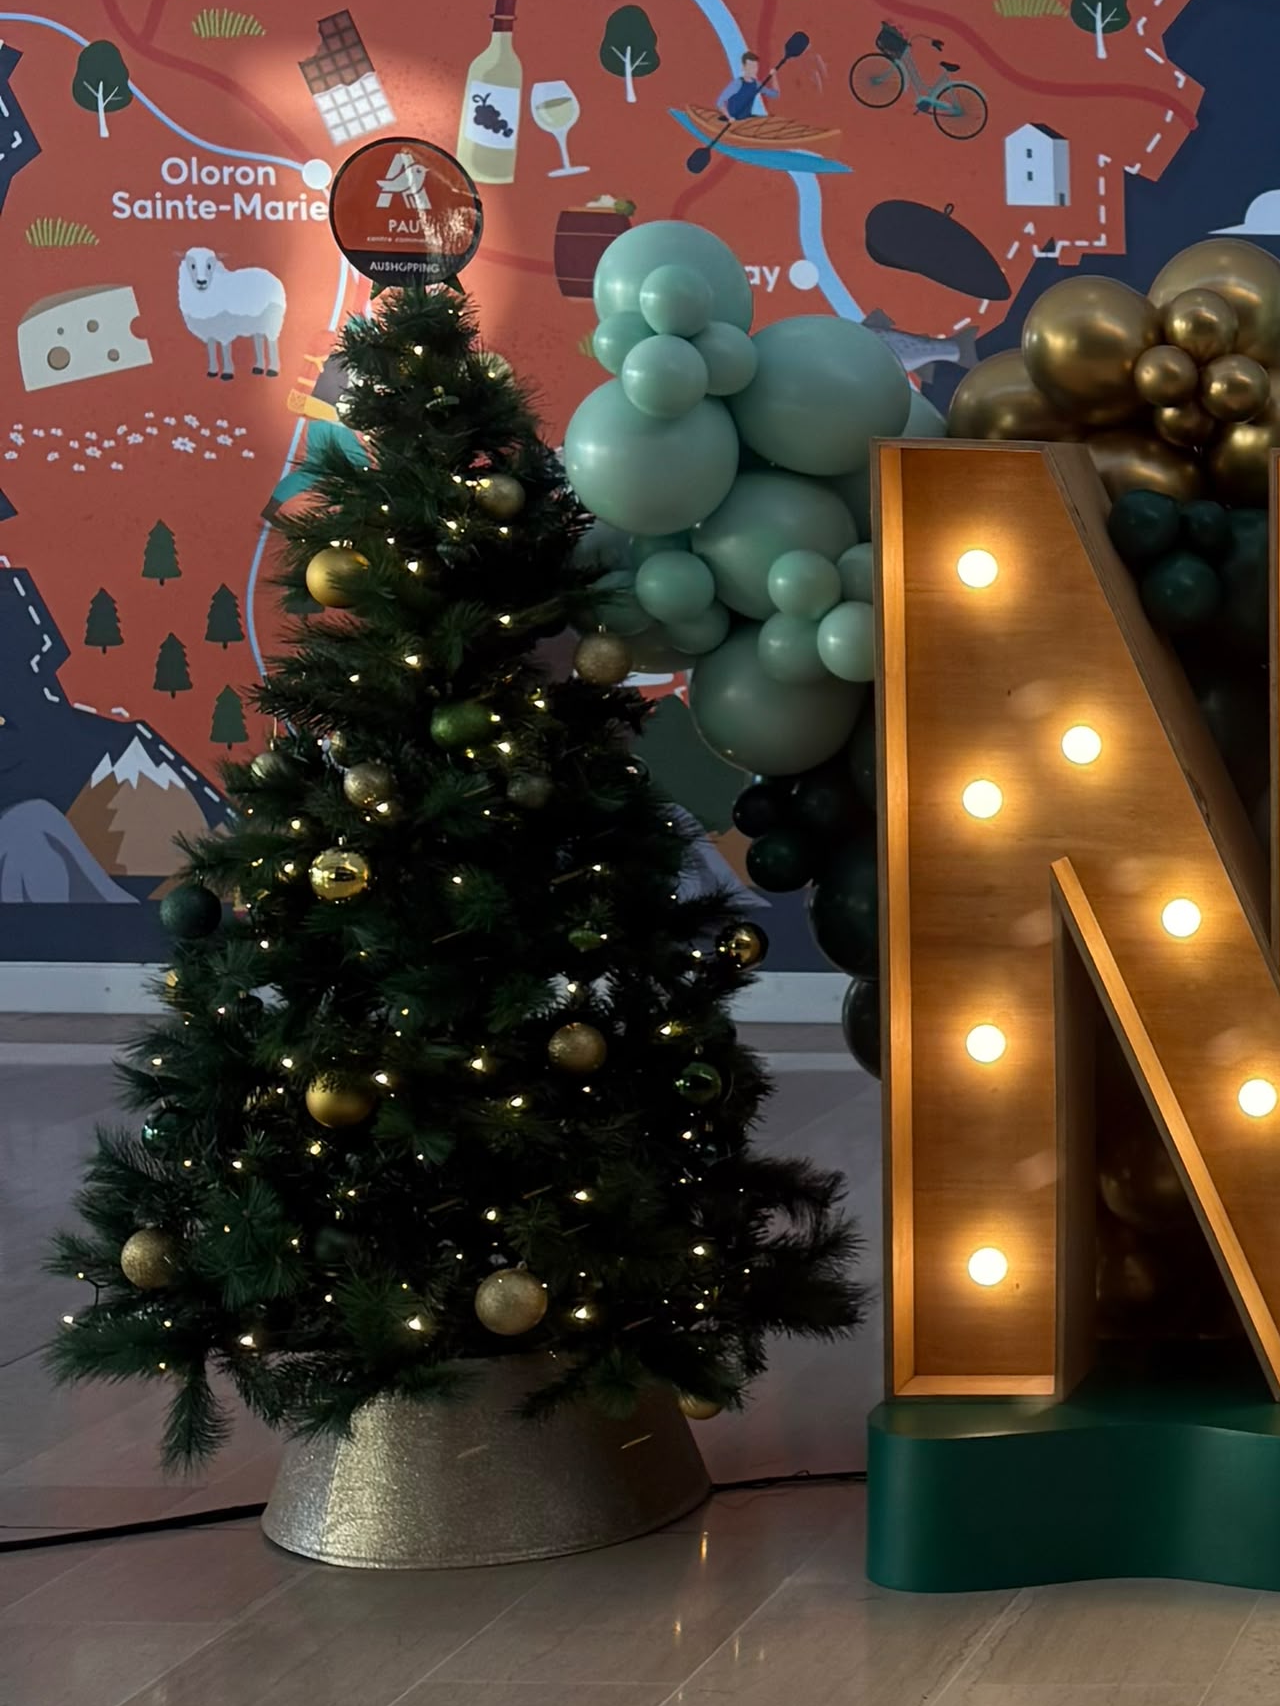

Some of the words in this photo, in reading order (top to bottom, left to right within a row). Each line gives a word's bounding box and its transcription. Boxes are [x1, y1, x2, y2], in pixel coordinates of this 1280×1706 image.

[160, 156, 277, 186] Oloron
[111, 191, 330, 221] Sainte-Marie
[388, 218, 420, 234] PAU
[369, 261, 441, 273] AUSHOPPING
[743, 265, 782, 293] ay
